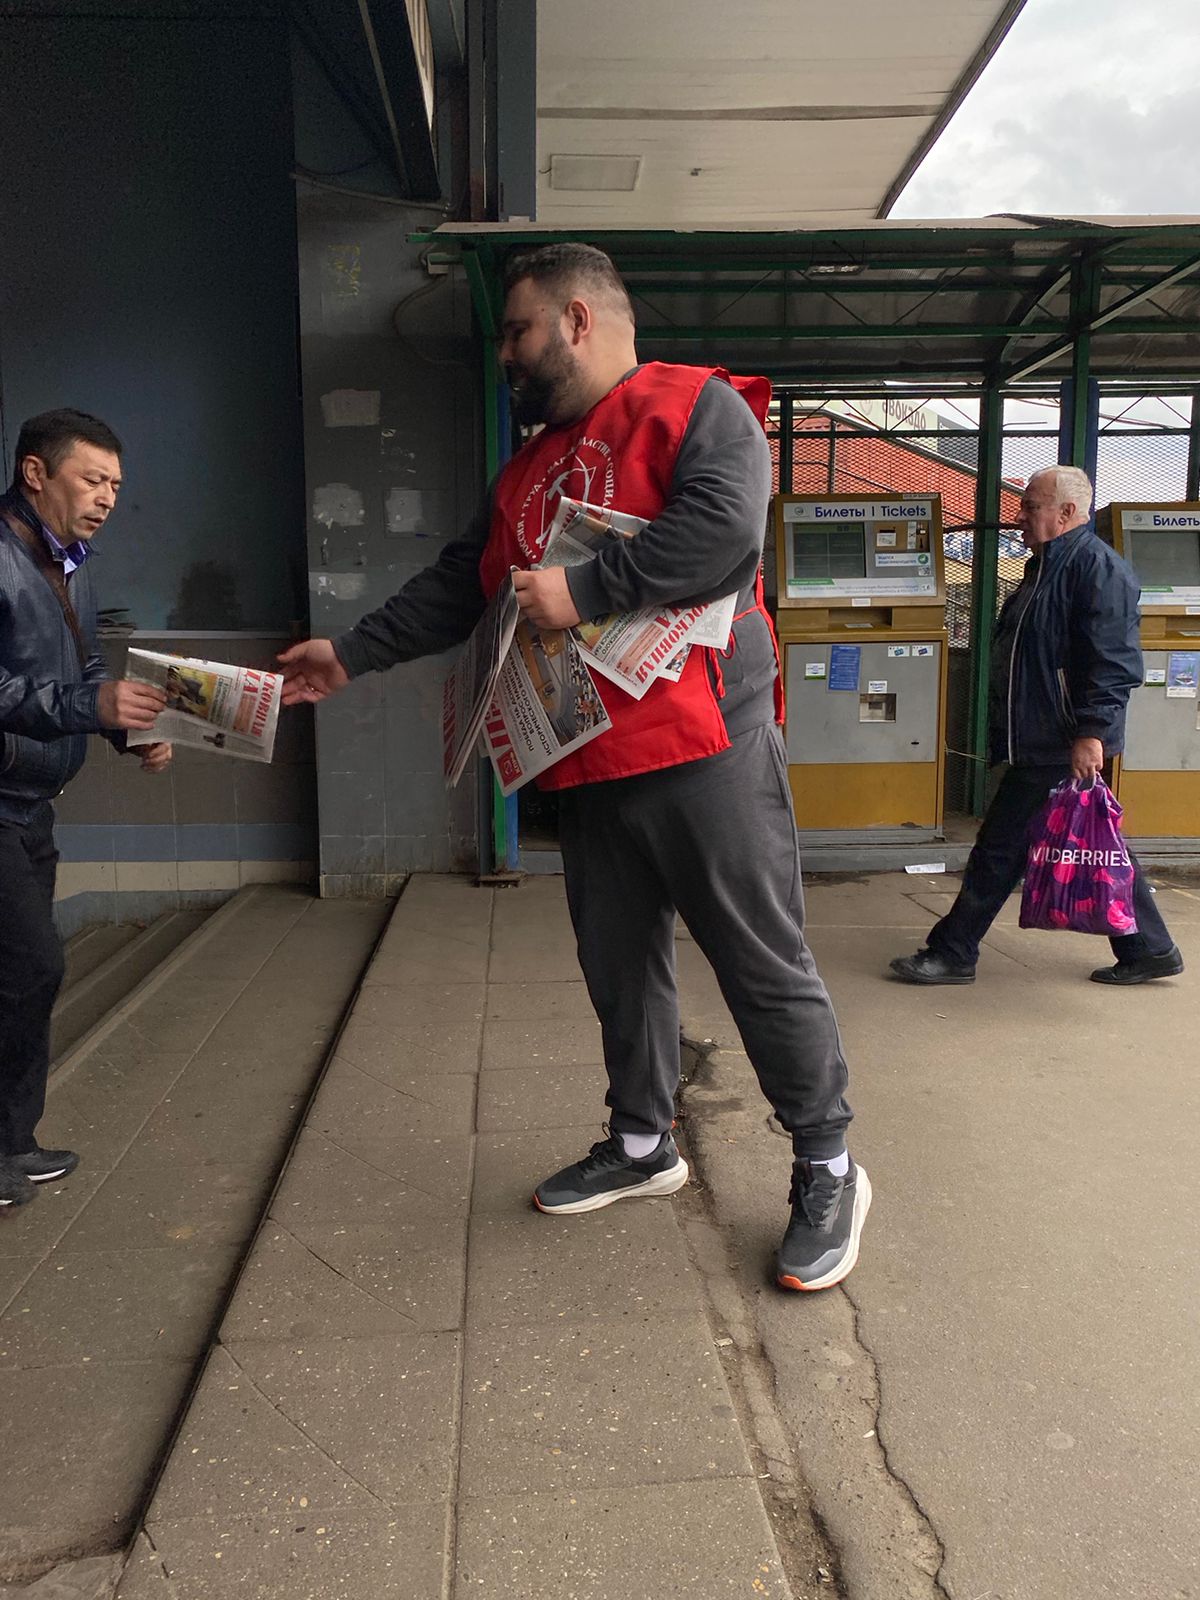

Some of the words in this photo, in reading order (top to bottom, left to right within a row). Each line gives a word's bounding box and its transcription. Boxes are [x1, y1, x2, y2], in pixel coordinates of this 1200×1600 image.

[603, 462, 614, 507] СОЦИА
[814, 506, 866, 518] Билеты
[881, 505, 927, 517] Tickets
[519, 703, 535, 735] ВОПРОС
